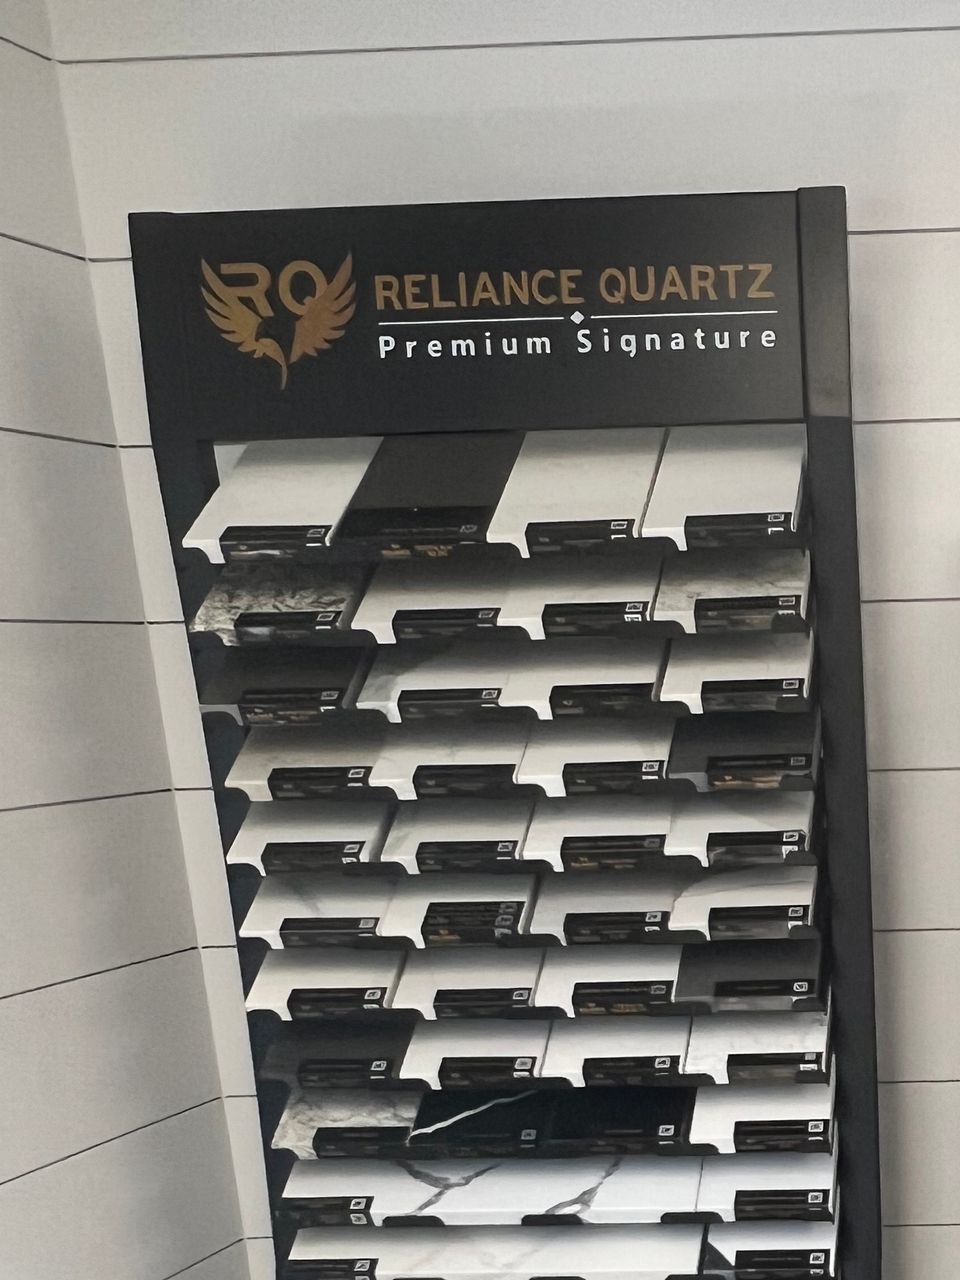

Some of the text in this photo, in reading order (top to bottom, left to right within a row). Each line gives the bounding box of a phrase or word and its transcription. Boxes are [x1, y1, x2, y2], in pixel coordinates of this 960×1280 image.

[375, 262, 776, 311] RELIANCE QUARTZ
[379, 328, 777, 358] Premium Signature
